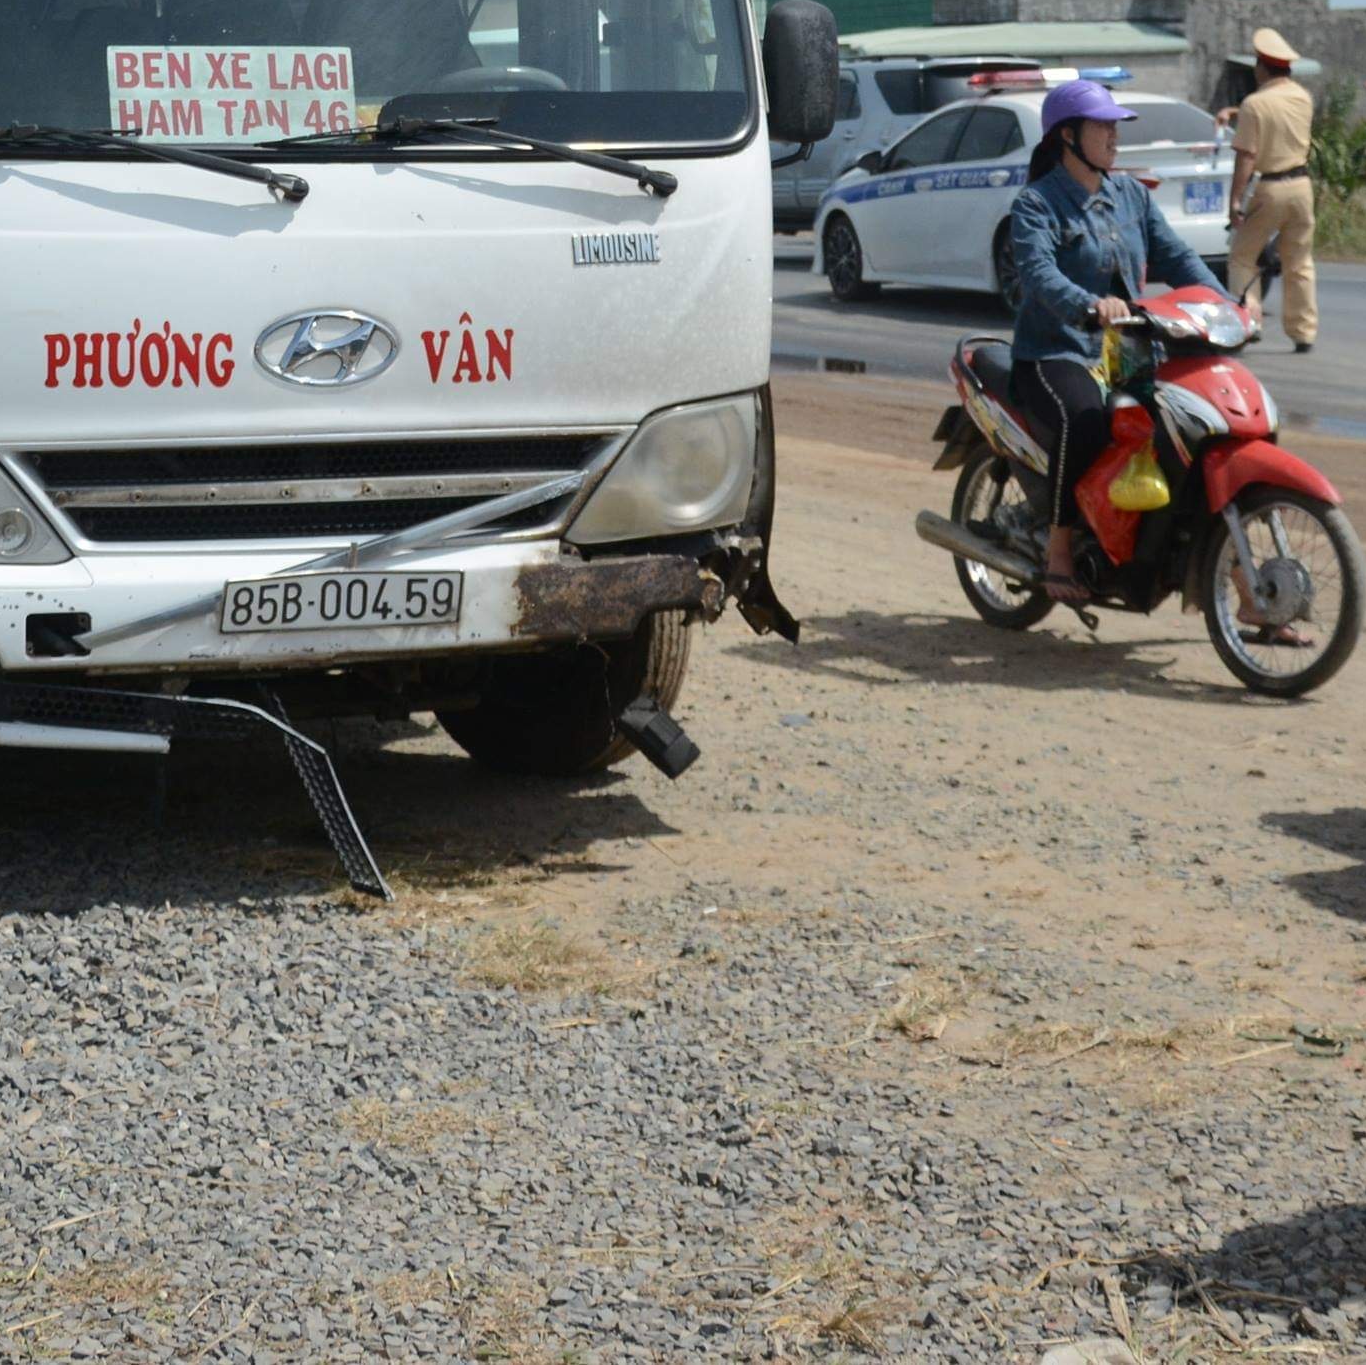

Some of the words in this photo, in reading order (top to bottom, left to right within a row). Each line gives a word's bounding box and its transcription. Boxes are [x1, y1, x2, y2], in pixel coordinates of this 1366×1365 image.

[114, 52, 192, 89] BEN
[205, 53, 253, 90] XE
[267, 53, 349, 91] LAGI
[118, 100, 204, 136] HAM
[217, 100, 291, 136] TAN
[303, 100, 351, 135] 46
[571, 233, 661, 266] LIMOUSINE
[44, 318, 235, 388] PHƯƠNG
[420, 312, 515, 384] VÂN
